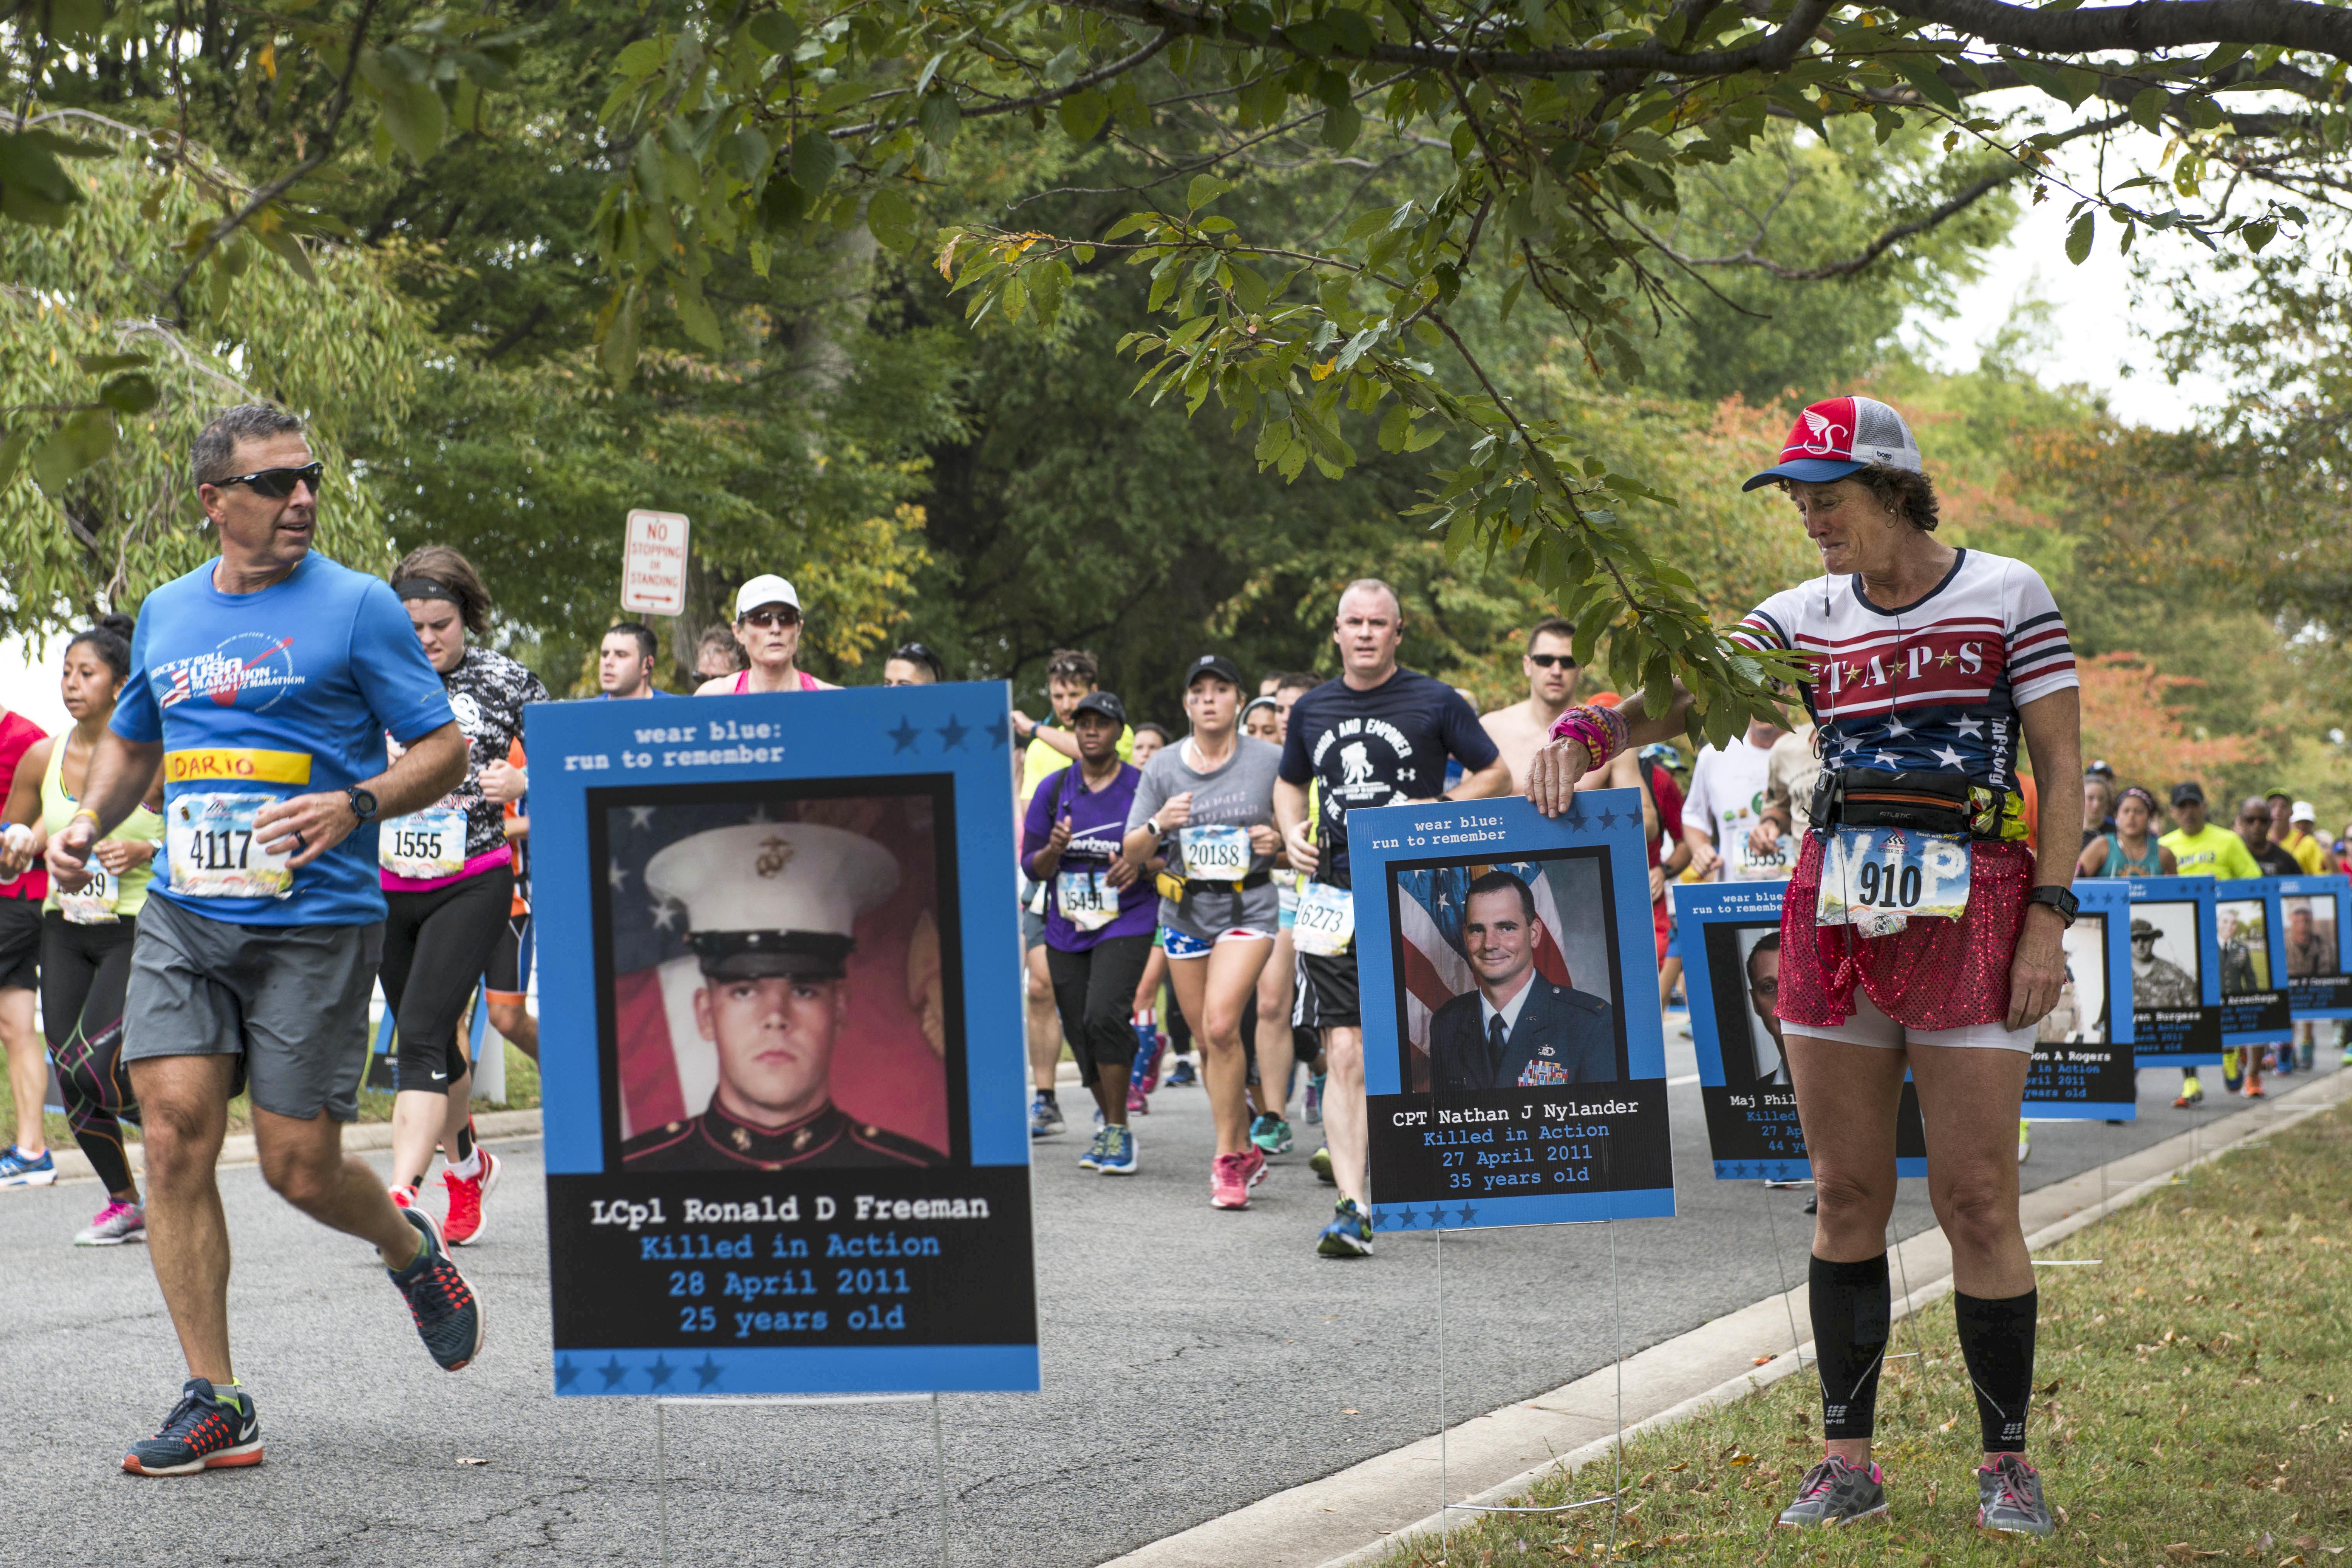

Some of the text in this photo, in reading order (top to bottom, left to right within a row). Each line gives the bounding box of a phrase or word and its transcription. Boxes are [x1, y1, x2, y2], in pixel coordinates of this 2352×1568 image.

[647, 523, 667, 541] NO
[631, 541, 682, 558] STOPPING
[650, 561, 660, 570] OR
[631, 571, 679, 588] STANDING
[190, 657, 243, 680] USA
[191, 667, 270, 690] MARATHON
[635, 720, 781, 744] wear blue:
[1339, 718, 1361, 738] AND
[1365, 718, 1413, 759] EMPOWER
[564, 745, 785, 771] run to remember
[1415, 816, 1504, 832] wear blue:
[191, 831, 252, 869] 4117
[395, 831, 441, 858] 1555
[1373, 829, 1506, 849] run to remember
[1189, 844, 1239, 866] 20188
[1859, 861, 1922, 907] 910
[1692, 906, 1713, 914] run
[1736, 903, 1783, 912] remembe
[2054, 1051, 2063, 1061] A
[2068, 1051, 2111, 1063] Rogers
[2038, 1063, 2052, 1073] in
[2058, 1064, 2100, 1074] Action
[2025, 1075, 2085, 1087] pril 2011
[1729, 1095, 1756, 1108] Maj
[2024, 1088, 2087, 1098] years old
[1393, 1100, 1639, 1126] CPT Nathan J Nylander
[1746, 1110, 1797, 1122] Killed
[1424, 1124, 1610, 1146] Killed in Action
[1761, 1125, 1777, 1136] 27
[1443, 1144, 1592, 1168] 27 April 2011
[1768, 1141, 1784, 1151] 44
[1450, 1167, 1590, 1190] 35 years old
[591, 1195, 989, 1230] LCpl Ronald D Freeman
[640, 1232, 940, 1260] Killed in Action
[670, 1268, 911, 1301] 28 April 2011
[680, 1304, 906, 1338] 25 years old
